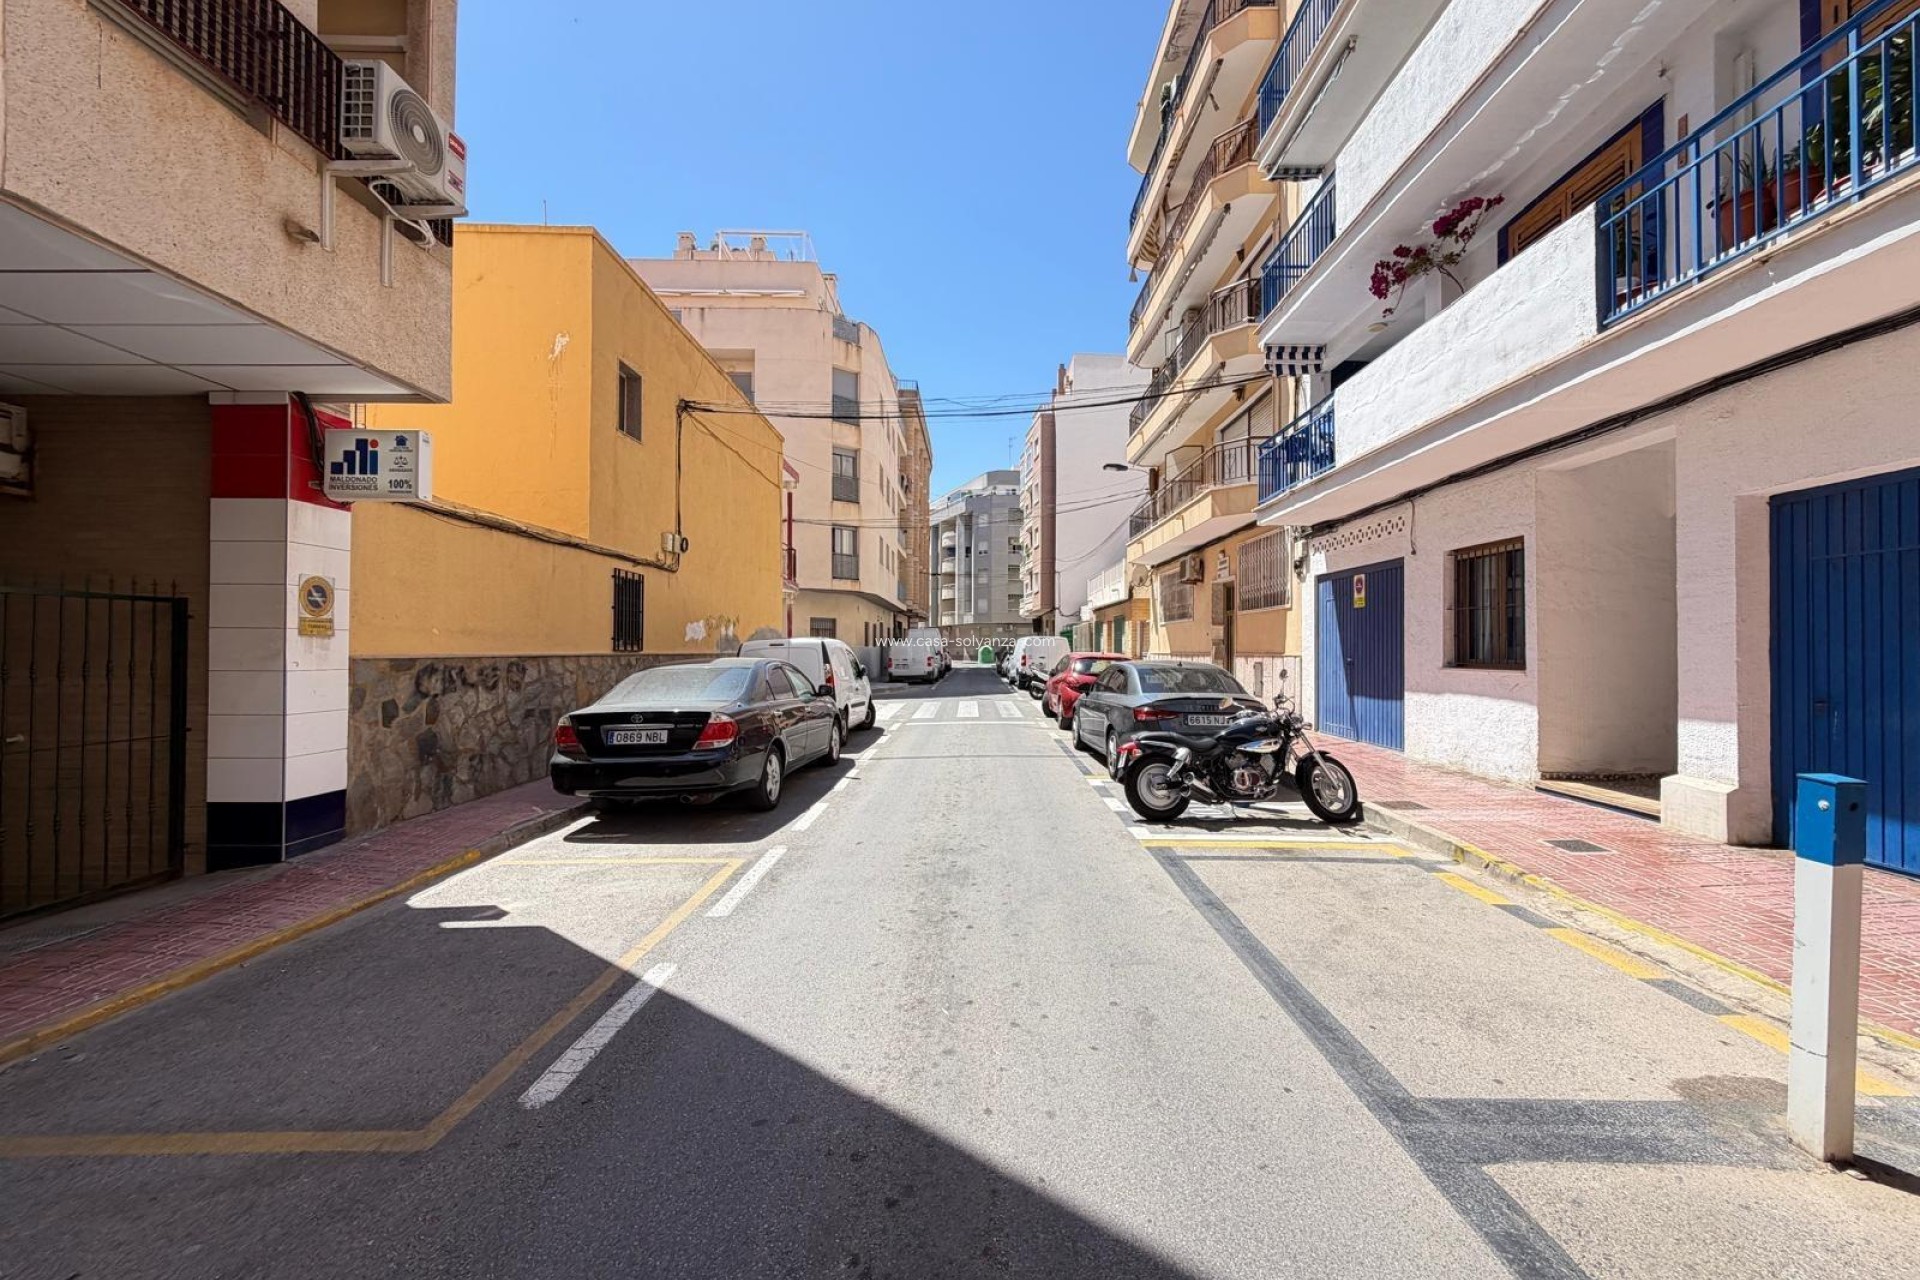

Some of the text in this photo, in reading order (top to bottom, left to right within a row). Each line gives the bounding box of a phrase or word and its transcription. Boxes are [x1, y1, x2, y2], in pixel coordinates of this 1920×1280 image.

[388, 479, 412, 490] 100%
[1189, 716, 1212, 725] 6615
[616, 731, 665, 743] 0869 NBL
